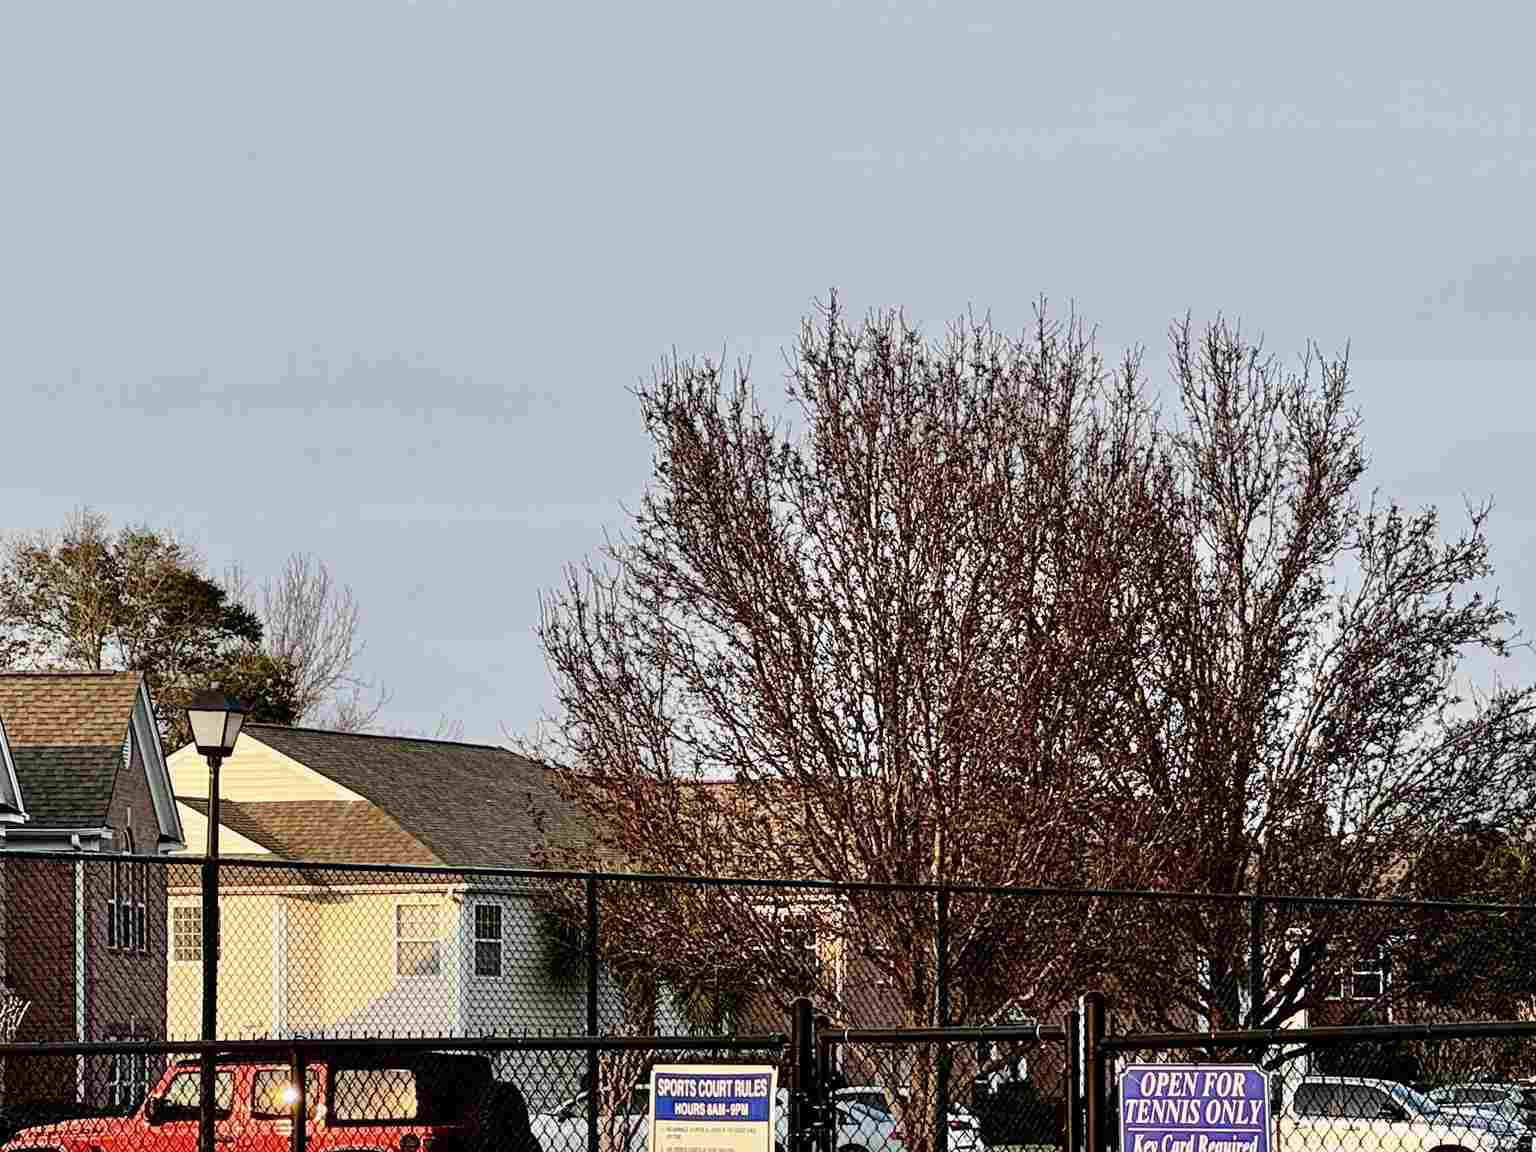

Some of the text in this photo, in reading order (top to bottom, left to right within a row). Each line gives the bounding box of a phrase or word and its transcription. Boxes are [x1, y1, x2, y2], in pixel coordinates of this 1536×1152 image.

[658, 1078, 768, 1097] SPORTS COURT RULES
[1140, 1072, 1246, 1097] OPEN FOR
[674, 1102, 705, 1116] HOURS
[1125, 1099, 1263, 1125] TENNIS ONLY
